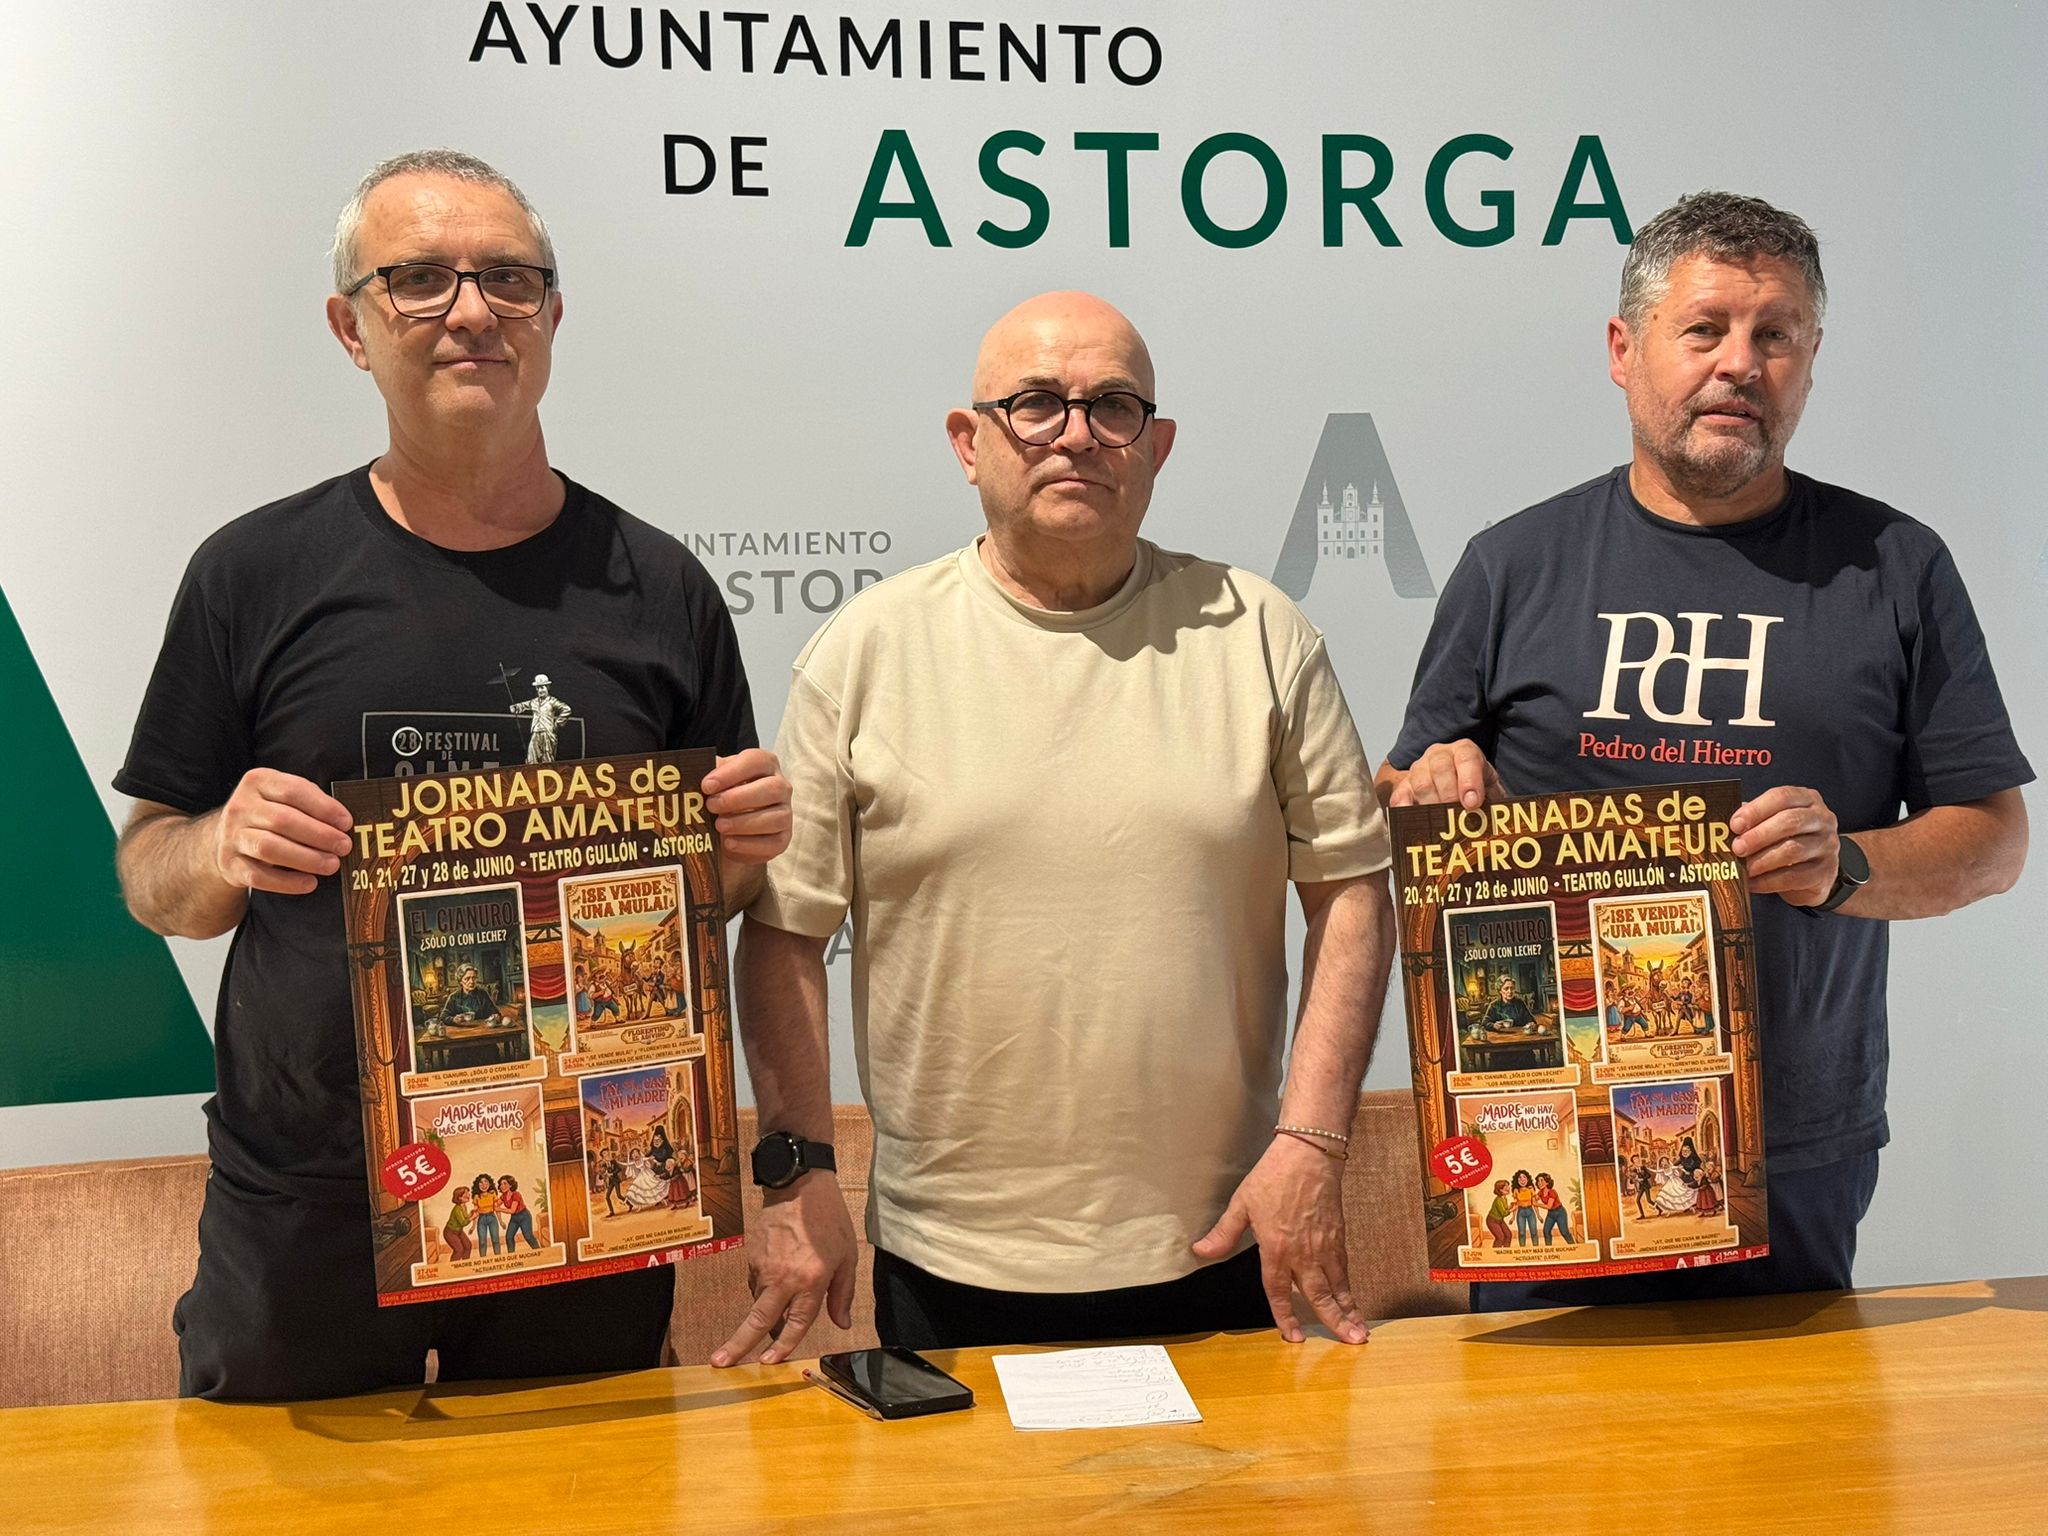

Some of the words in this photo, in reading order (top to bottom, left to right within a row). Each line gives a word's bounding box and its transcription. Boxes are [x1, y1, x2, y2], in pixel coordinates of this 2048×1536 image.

[469, 1, 1163, 86] AYUNTAMIENTO
[663, 133, 770, 197] DE
[844, 129, 1634, 249] ASTORGA
[684, 531, 891, 556] NTAMIENTO
[399, 732, 416, 750] 28
[425, 732, 500, 751] FESTIVAL
[1577, 732, 1646, 761] Pedro
[1651, 738, 1685, 764] del
[1691, 740, 1772, 766] Hierro
[442, 751, 453, 760] DE
[390, 762, 617, 818] JORNADAS
[629, 757, 681, 794] de
[353, 810, 508, 860] TEATRO
[519, 791, 706, 843] AMATEUR
[1437, 793, 1644, 841] JORNADAS
[1655, 788, 1706, 823] de
[1405, 836, 1542, 877] TEATRO
[1553, 820, 1731, 865] AMATEUR
[351, 872, 373, 894] 20,
[375, 867, 399, 892] 21,
[400, 864, 418, 885] 27
[420, 868, 430, 888] y
[431, 860, 450, 882] 28
[451, 858, 470, 880] de
[471, 853, 515, 878] JUNIO
[529, 846, 582, 872] TEATRO
[584, 836, 638, 866] GULLÓN
[652, 832, 713, 858] ASTORGA
[581, 886, 606, 904] ¡SE
[609, 880, 662, 900] VENDE
[1403, 885, 1424, 908] 20,
[1425, 883, 1444, 906] 21,
[1446, 882, 1462, 901] 27
[1464, 886, 1473, 905] y
[1474, 880, 1490, 899] 28
[1492, 878, 1508, 898] de
[1509, 875, 1549, 897] JUNIO
[1561, 870, 1611, 893] TEATRO
[1613, 862, 1664, 888] GULLÓN
[1678, 860, 1739, 883] ASTORGA
[580, 901, 615, 920] UNA
[618, 895, 668, 915] MULA!
[1610, 908, 1634, 923] ¡SE
[1636, 904, 1688, 921] VENDE
[410, 909, 432, 935] EL
[1610, 922, 1642, 938] UNA
[1646, 918, 1695, 936] MULA!
[448, 934, 455, 947] O
[457, 932, 474, 946] CON
[476, 928, 507, 943] LECHE?
[1454, 924, 1474, 947] EL
[1489, 947, 1495, 958] O
[1496, 946, 1512, 958] CON
[1514, 943, 1542, 957] LECHE?
[432, 1102, 484, 1127] MADRE
[486, 1104, 498, 1113] NO
[500, 1101, 517, 1112] HAY
[438, 1123, 456, 1136] MÁS
[457, 1122, 474, 1132] QUE
[475, 1110, 523, 1134] MUCHAS
[1476, 1102, 1522, 1123] MADRE
[1524, 1106, 1535, 1114] NO
[1537, 1104, 1552, 1114] HAY
[1480, 1120, 1496, 1131] MÁS
[1498, 1121, 1512, 1129] QUE
[1514, 1114, 1557, 1133] MUCHAS
[397, 1154, 437, 1186] 5€
[1444, 1147, 1479, 1174] 5€
